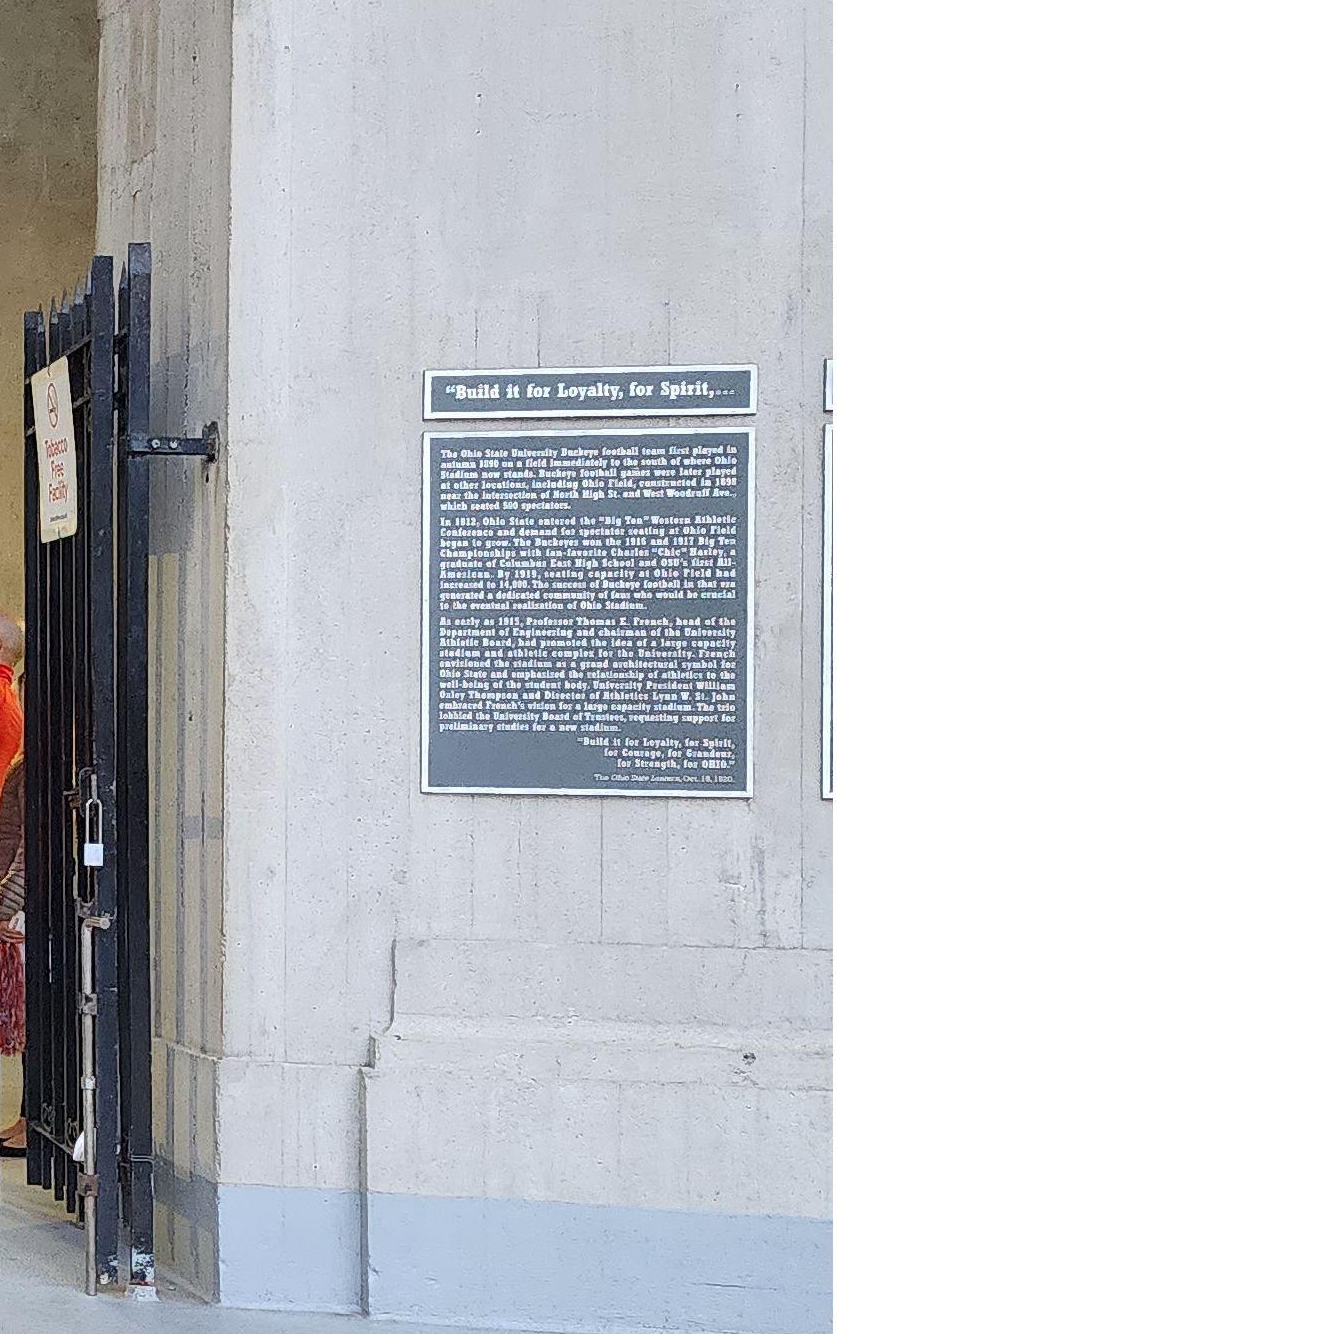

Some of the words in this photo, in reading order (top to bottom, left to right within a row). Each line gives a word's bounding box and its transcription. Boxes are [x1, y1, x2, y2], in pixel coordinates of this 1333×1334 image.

[506, 383, 520, 399] it
[526, 383, 551, 398] for
[557, 382, 624, 401] Loyalty,
[629, 381, 654, 397] for
[45, 437, 68, 459] Tobacco
[51, 460, 64, 479] Free
[48, 480, 68, 504] Facility
